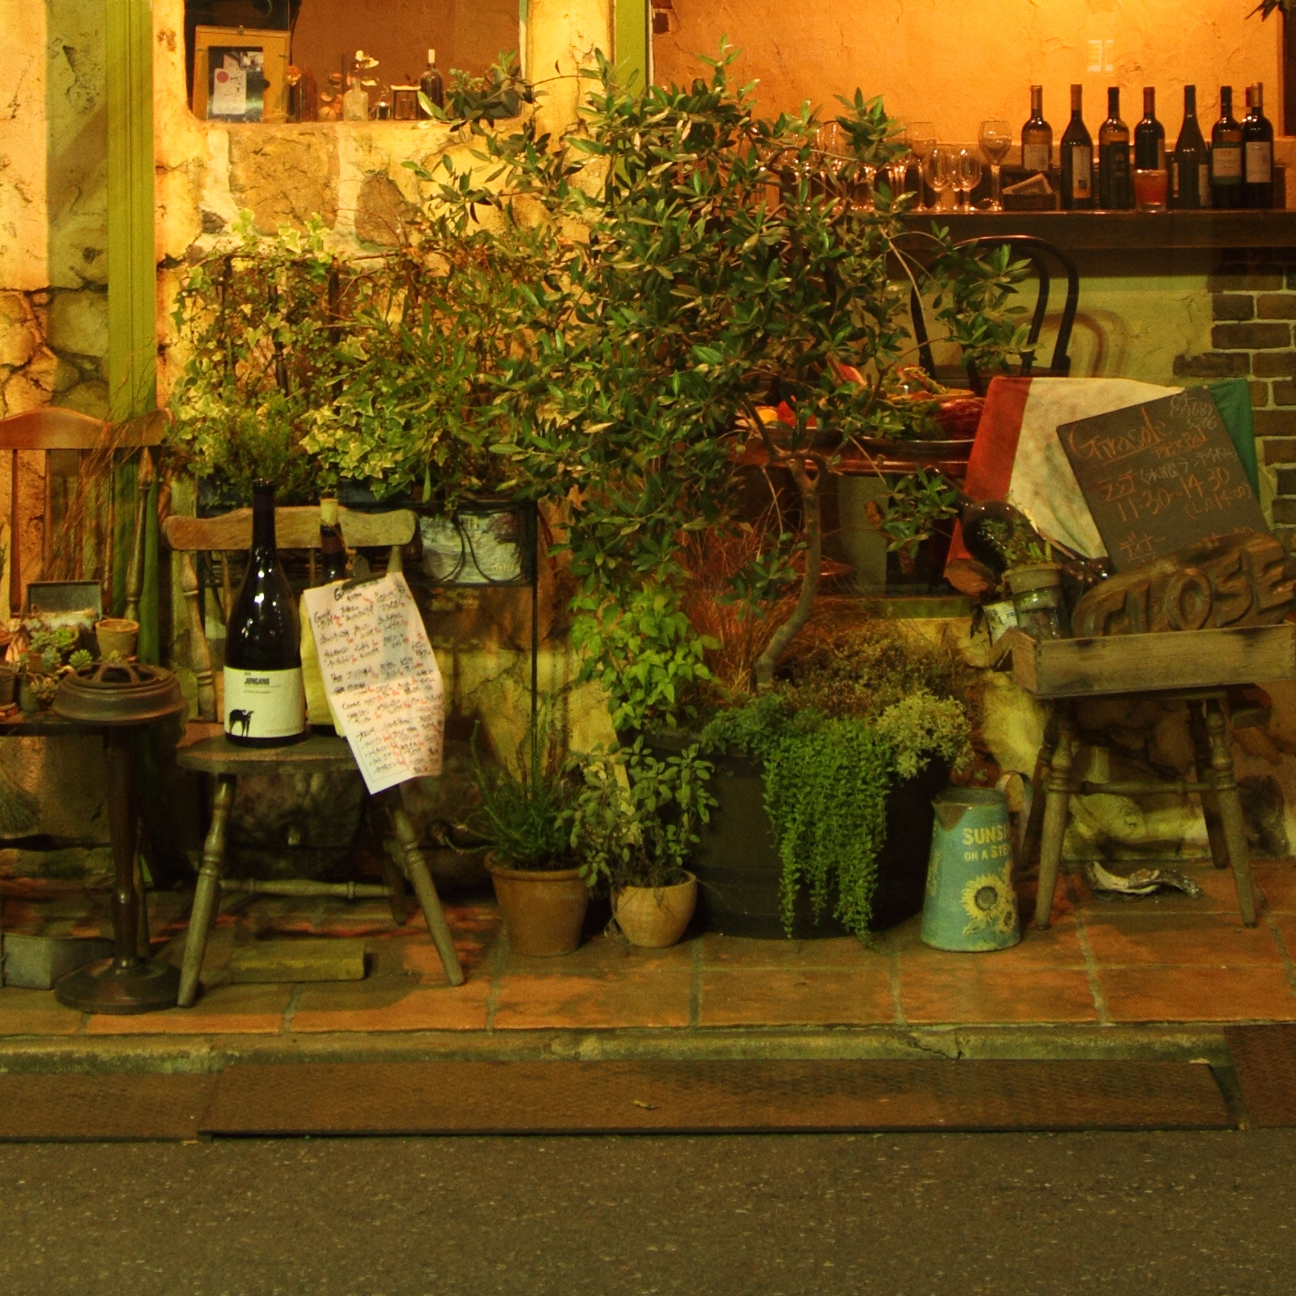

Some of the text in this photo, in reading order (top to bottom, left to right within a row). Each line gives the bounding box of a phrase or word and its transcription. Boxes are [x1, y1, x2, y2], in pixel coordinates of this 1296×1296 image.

[1068, 406, 1173, 461] Girasole
[964, 850, 979, 862] ON
[981, 850, 989, 860] A
